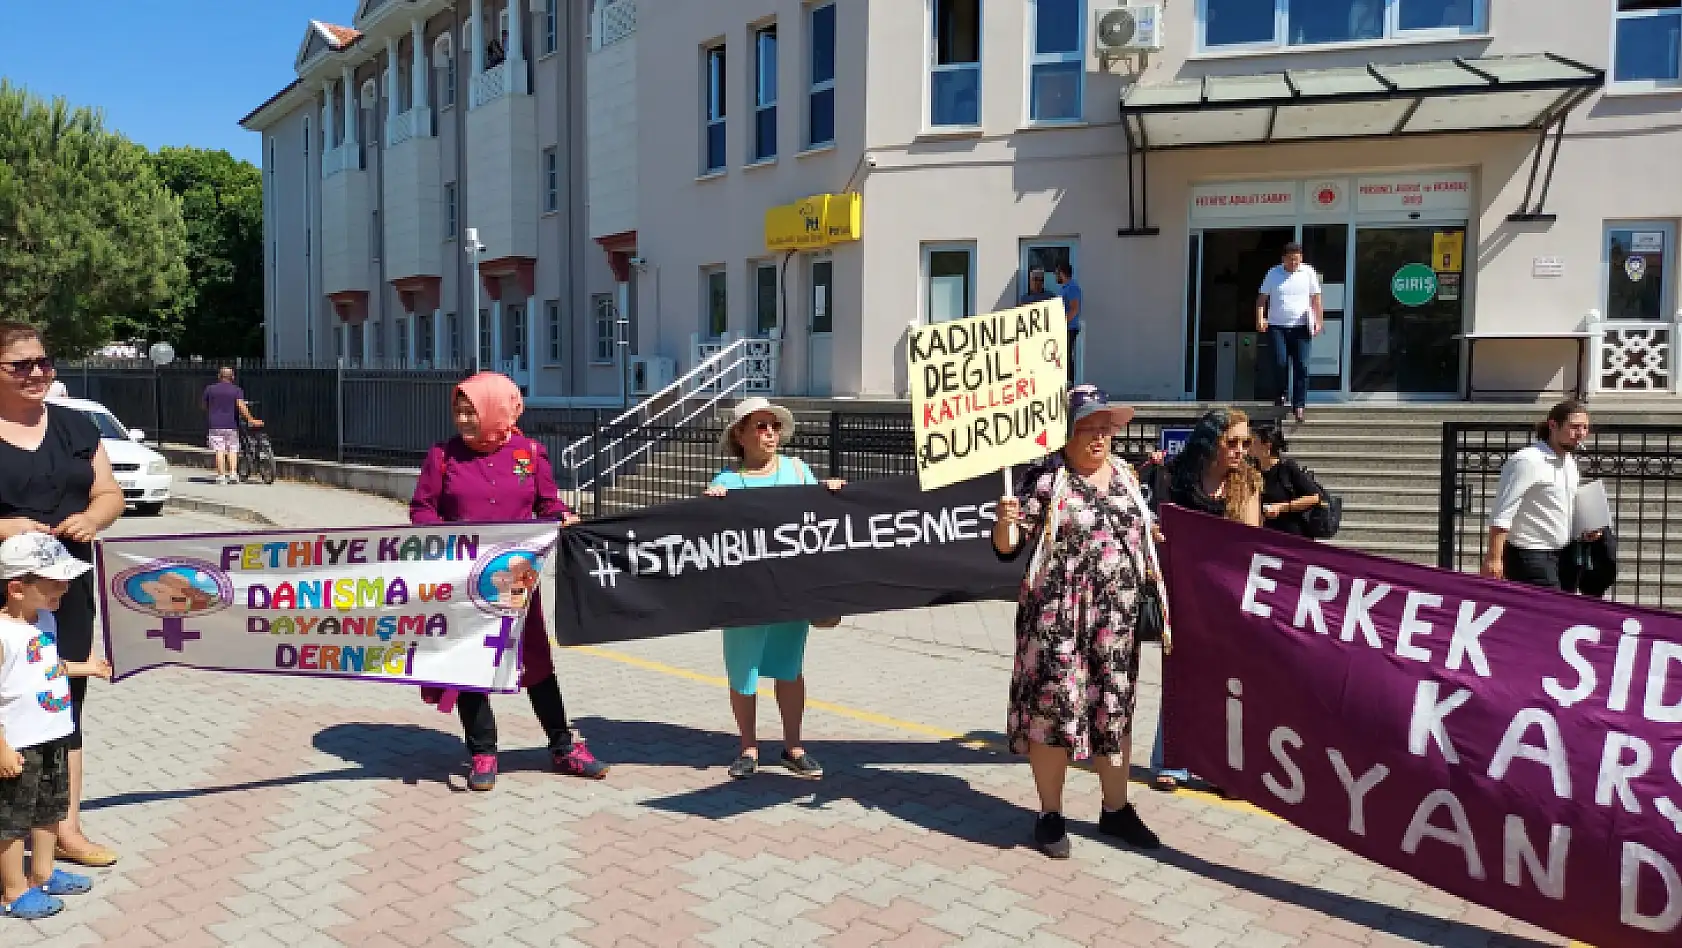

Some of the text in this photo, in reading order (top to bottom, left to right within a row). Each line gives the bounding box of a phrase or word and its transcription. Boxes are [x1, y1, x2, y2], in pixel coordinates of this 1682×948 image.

[909, 305, 1051, 364] KADINLARI
[220, 534, 480, 571] FETHİYE KADIN
[418, 582, 454, 602] ve
[246, 612, 448, 641] DAYANIŞMA
[1241, 552, 1506, 678] ERKEK
[275, 640, 419, 676] DERNEĞİ
[1224, 677, 1573, 901] İSYAN
